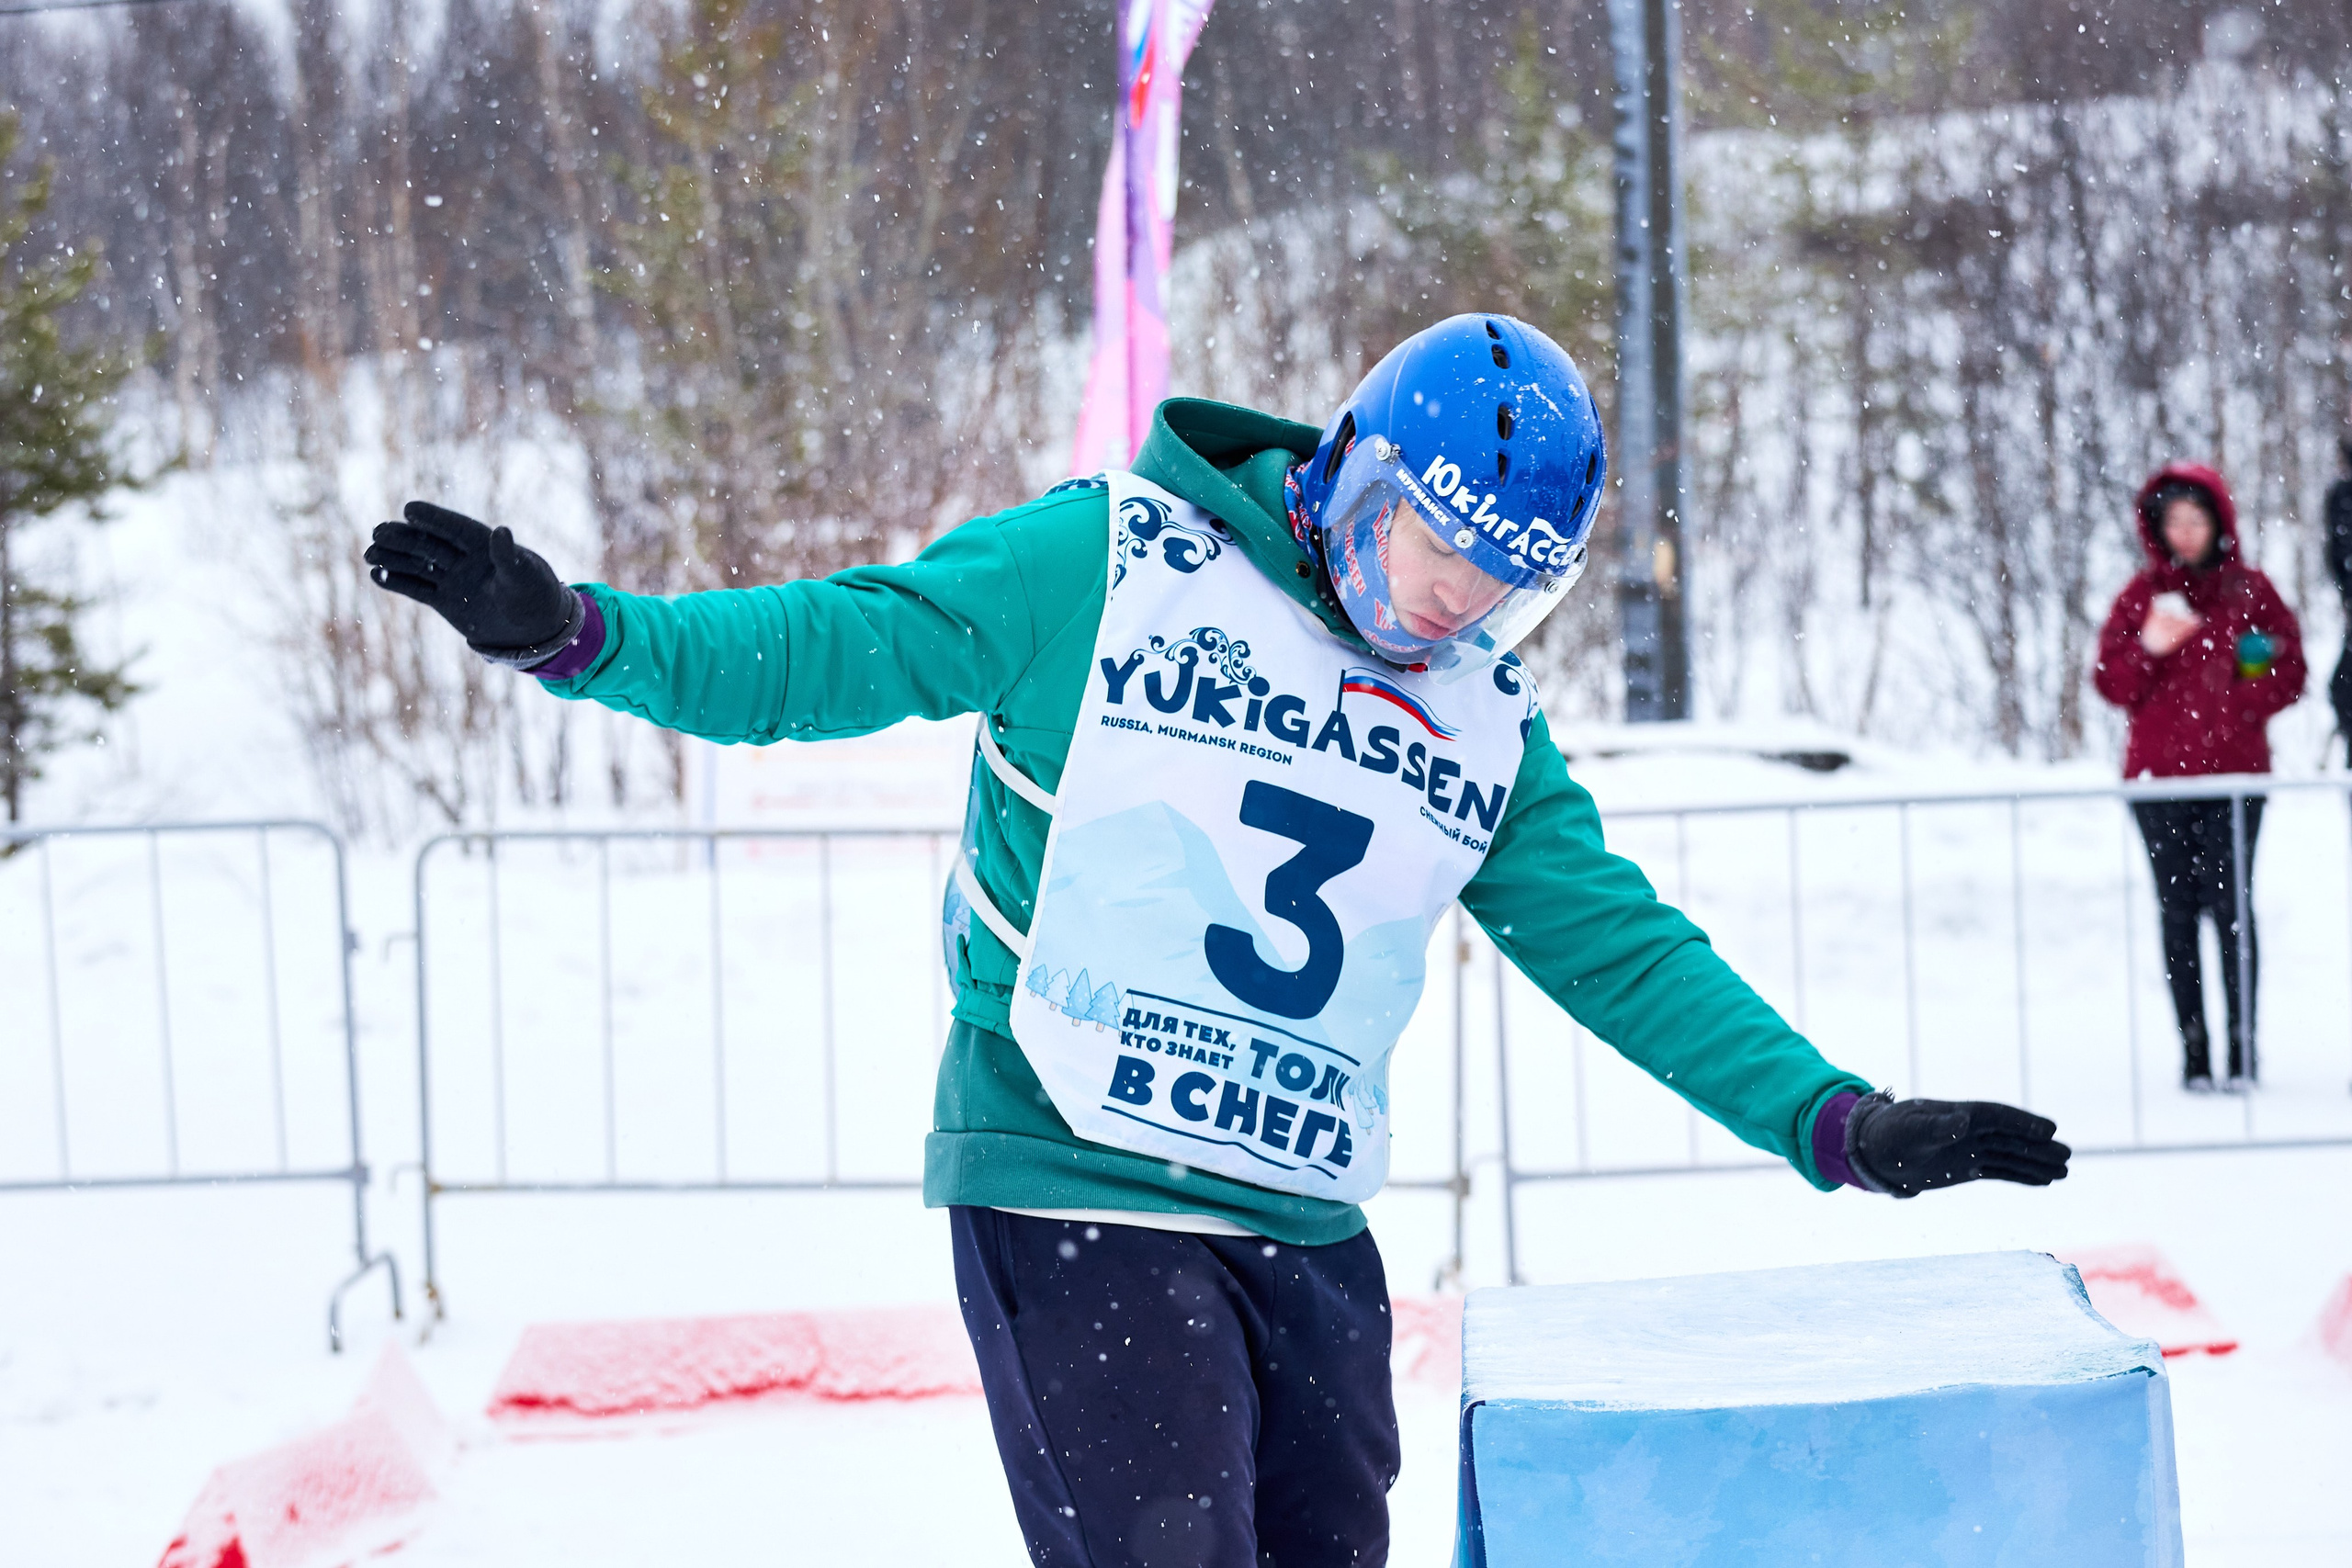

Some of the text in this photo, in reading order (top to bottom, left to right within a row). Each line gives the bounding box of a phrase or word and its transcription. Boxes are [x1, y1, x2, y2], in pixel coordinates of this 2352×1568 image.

[1396, 468, 1452, 527] МУРМАНСК
[1101, 715, 1293, 766] RUSSIA, MURMANSK REGION
[1462, 834, 1487, 854] БОЙ
[1204, 779, 1375, 1021] 3
[1120, 1031, 1234, 1069] КТО ЗНАЕТ
[1122, 1008, 1237, 1051] ДЛЯ ТЕХ,
[1108, 1055, 1156, 1106] В
